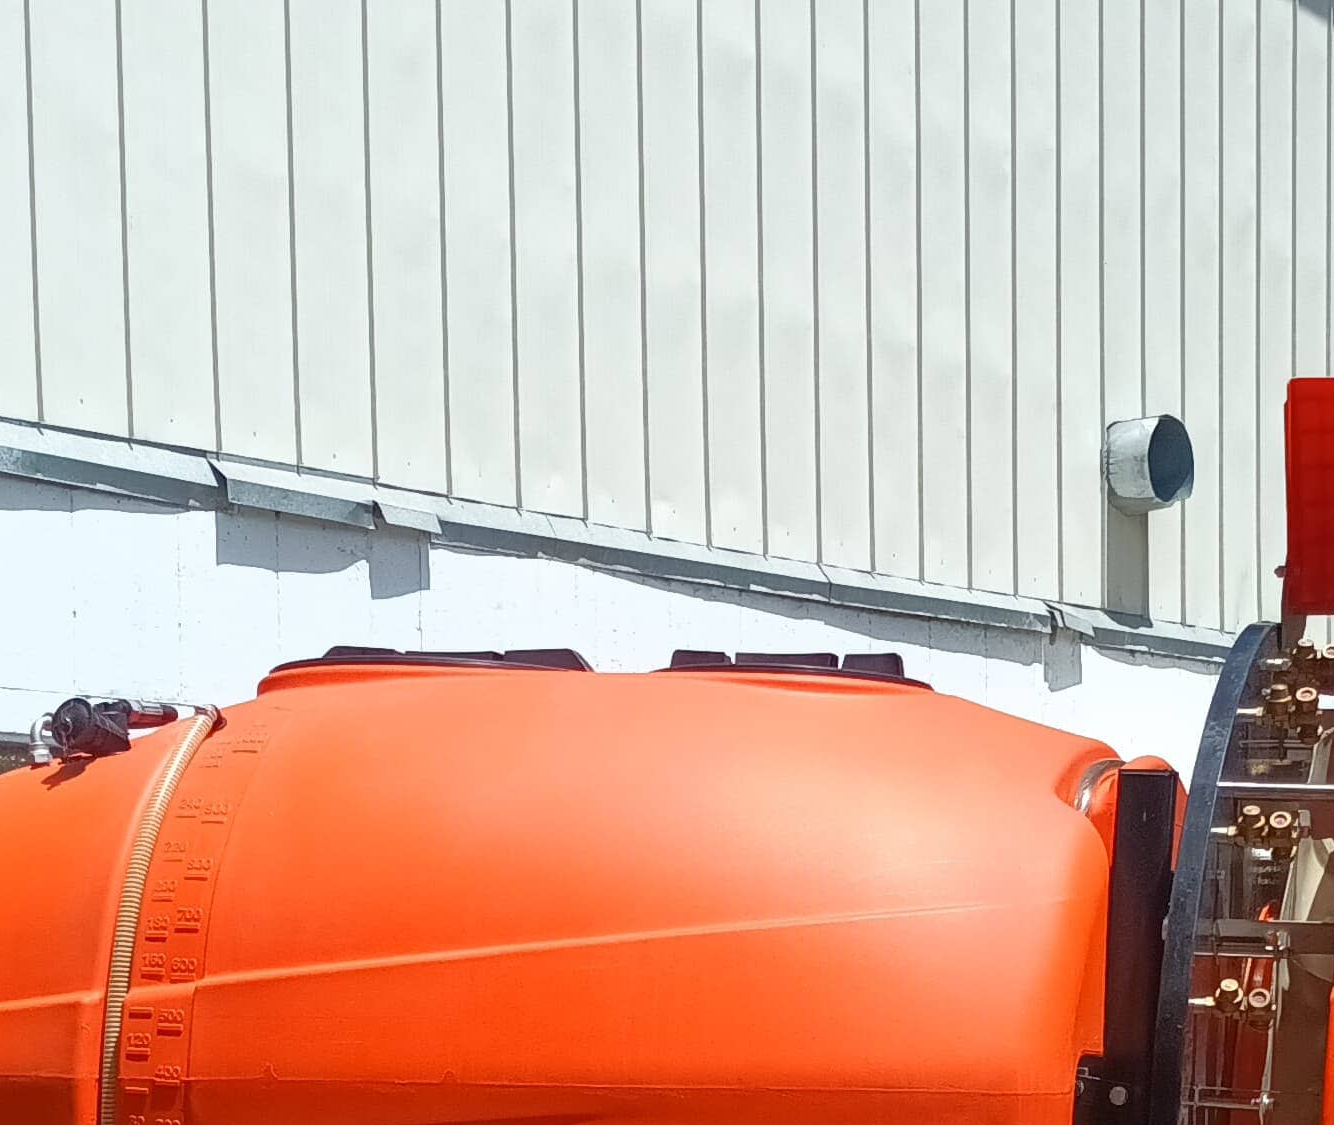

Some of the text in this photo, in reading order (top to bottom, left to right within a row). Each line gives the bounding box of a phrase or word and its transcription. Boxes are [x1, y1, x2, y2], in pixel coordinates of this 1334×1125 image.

[175, 907, 203, 923] 700
[170, 957, 197, 973] 600
[158, 1008, 184, 1022] 500
[126, 1033, 151, 1046] 120
